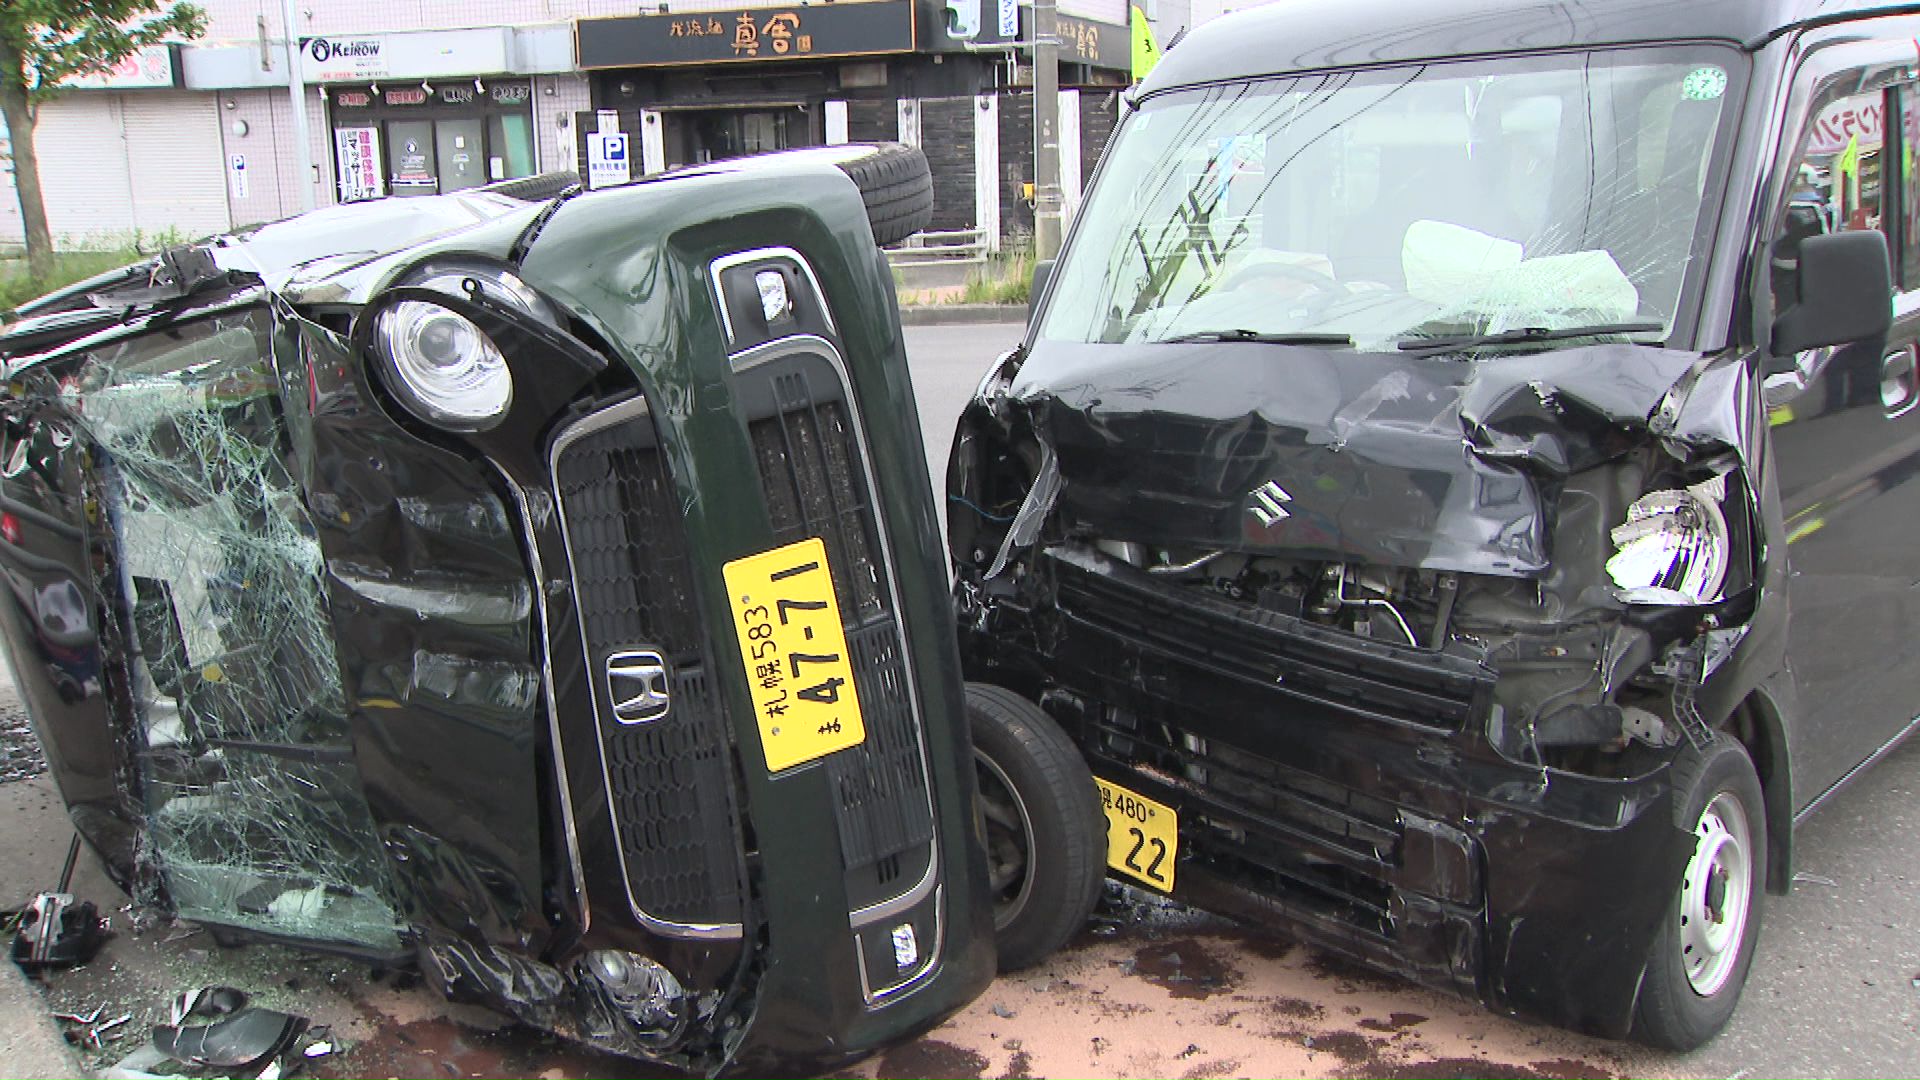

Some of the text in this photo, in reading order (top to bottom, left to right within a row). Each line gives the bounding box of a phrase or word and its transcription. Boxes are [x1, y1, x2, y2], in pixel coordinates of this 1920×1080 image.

[605, 137, 622, 159] P
[744, 605, 790, 719] 札幌583
[770, 561, 845, 705] 47-71
